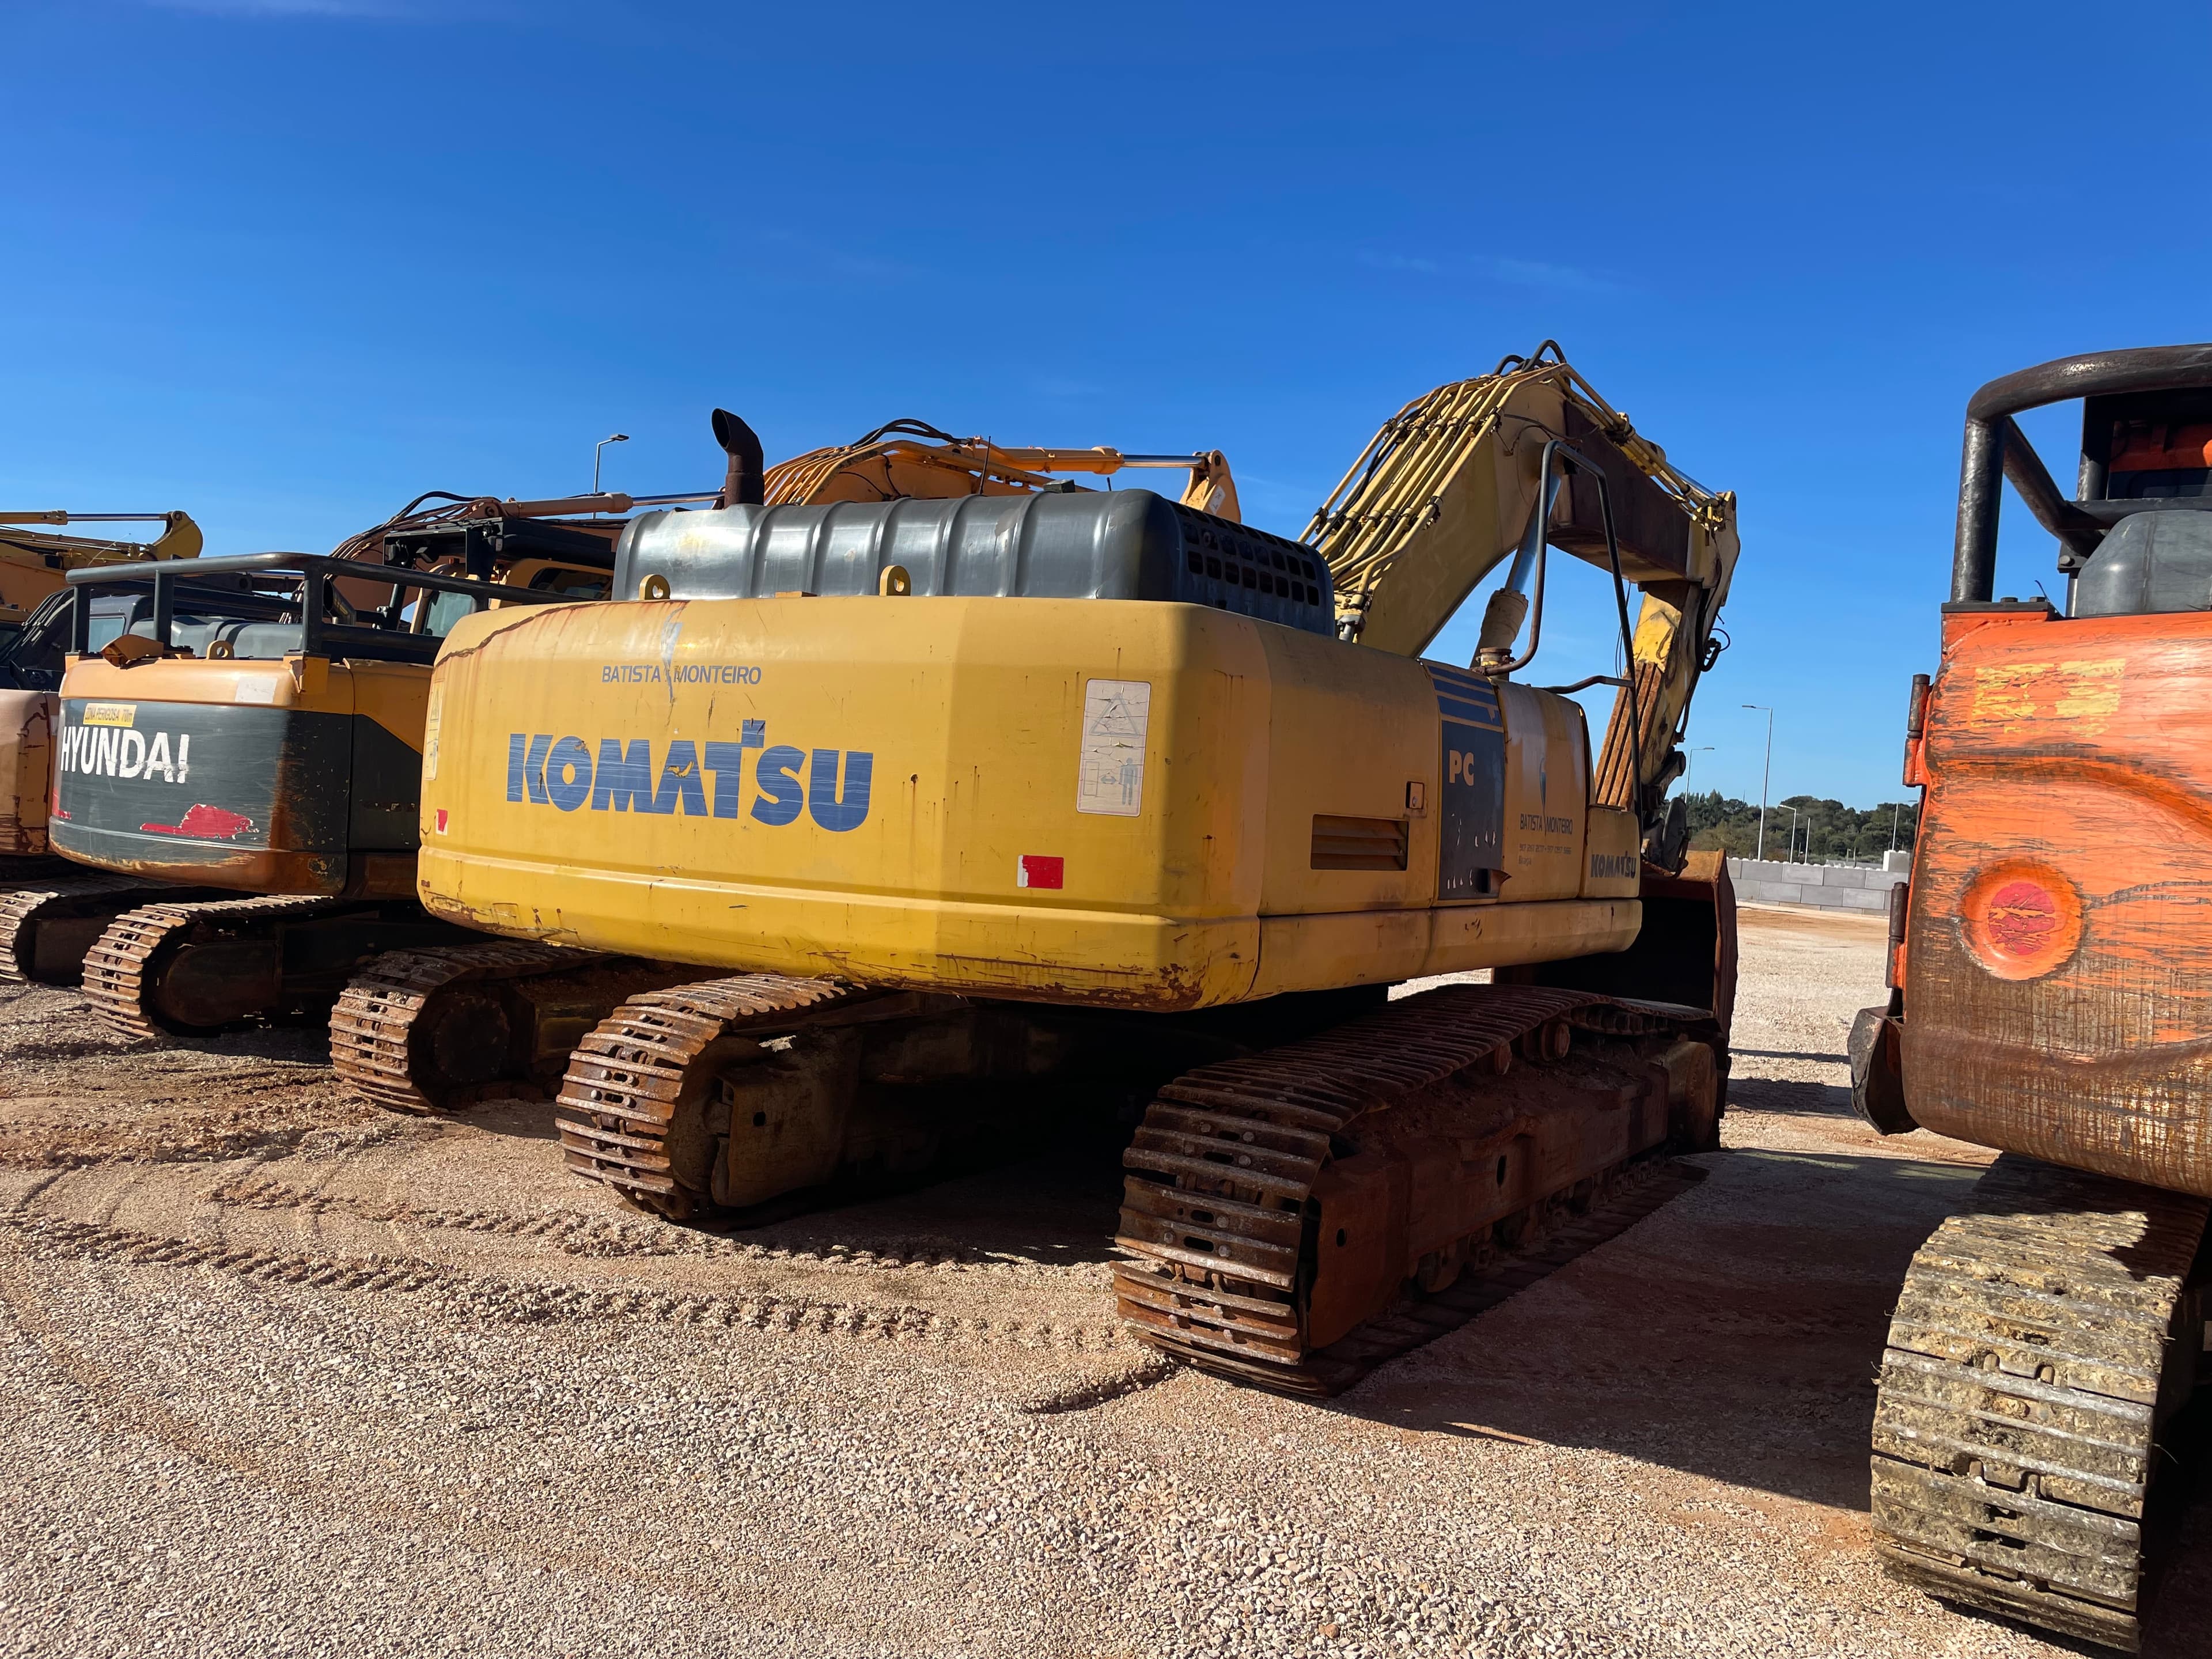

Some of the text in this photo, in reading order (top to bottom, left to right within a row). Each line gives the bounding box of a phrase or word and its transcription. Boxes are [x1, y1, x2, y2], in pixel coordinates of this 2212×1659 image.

[601, 665, 762, 685] BATISTA MONTEIRO
[96, 707, 120, 721] PERIGOSA
[60, 726, 190, 784] HYUNDAI
[1449, 749, 1475, 786] PC
[506, 718, 874, 833] KOMATSU
[1520, 813, 1574, 835] BATISTA MONTEIRO
[1590, 850, 1637, 879] KOMATSU
